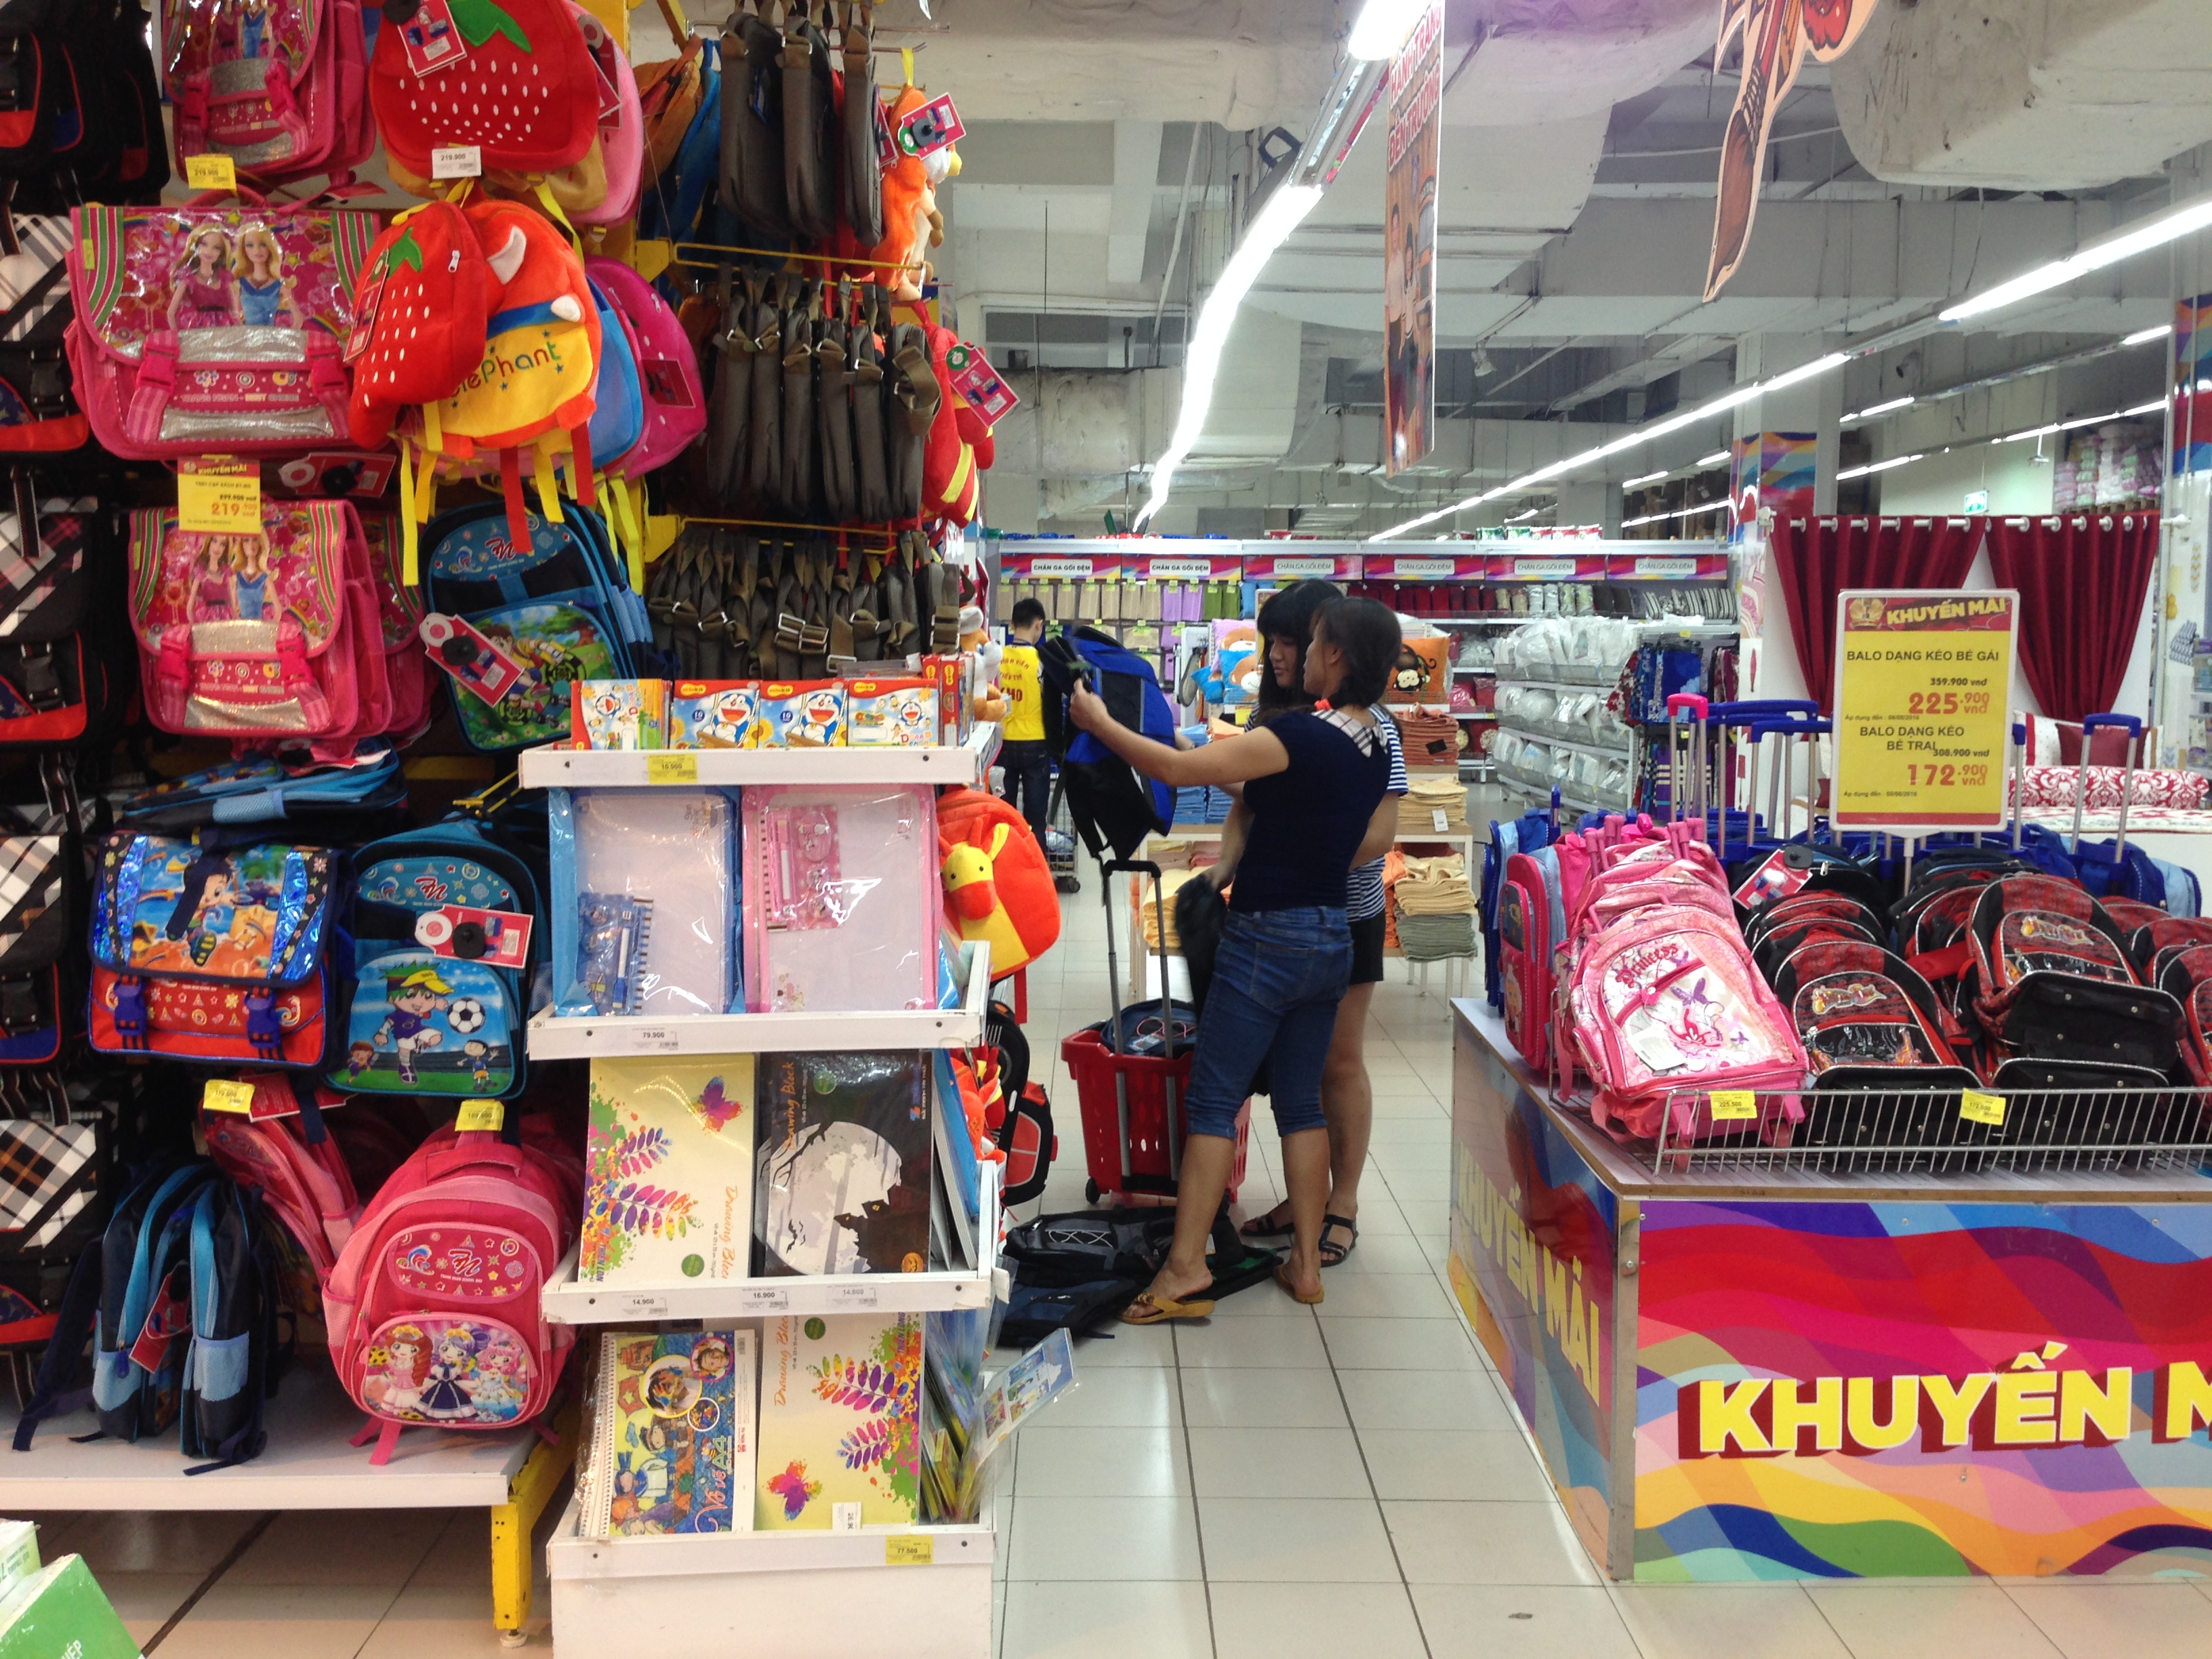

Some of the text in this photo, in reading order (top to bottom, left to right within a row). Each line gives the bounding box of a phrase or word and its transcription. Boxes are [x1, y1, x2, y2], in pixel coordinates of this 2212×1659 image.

[1846, 648, 1999, 663] BALO DẠNG KÉO BÉ GÁI
[1930, 677, 1968, 686] 359.900
[1860, 724, 1965, 739] BALO DẠNG KÉO
[1886, 738, 1904, 751] BÉ
[718, 1185, 739, 1243] Drawing
[774, 1349, 792, 1407] Drawing
[1697, 1340, 2133, 1454] KHUYẾN
[712, 1435, 728, 1470] A4
